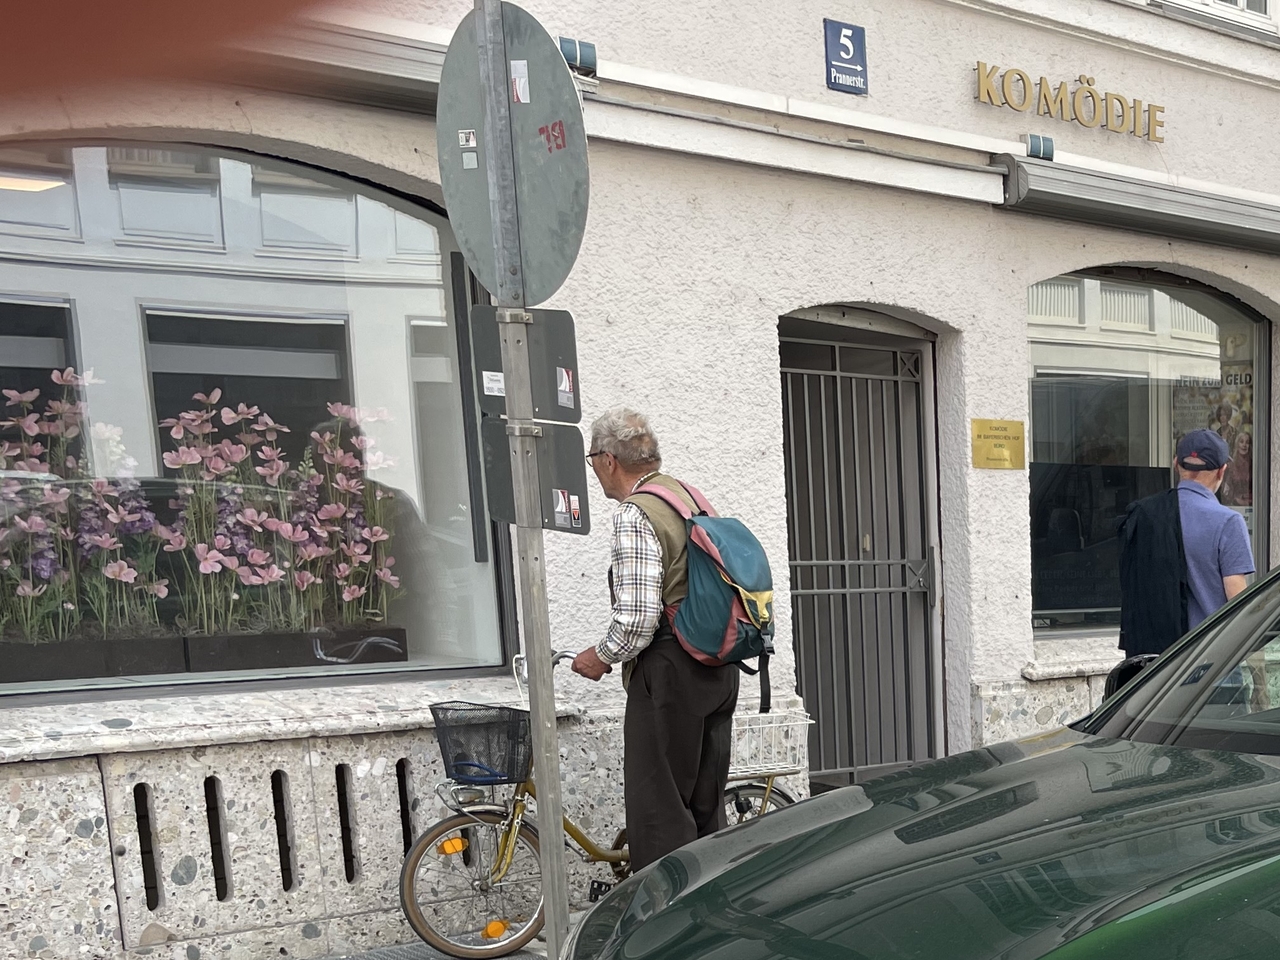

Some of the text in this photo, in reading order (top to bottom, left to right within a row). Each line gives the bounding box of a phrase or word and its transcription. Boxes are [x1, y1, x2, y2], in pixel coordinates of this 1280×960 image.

[839, 27, 855, 60] 5
[830, 67, 866, 89] Prannerstr.
[975, 60, 1166, 143] KOMÖDIE
[1175, 375, 1199, 388] NEIN
[1226, 372, 1253, 386] GELD
